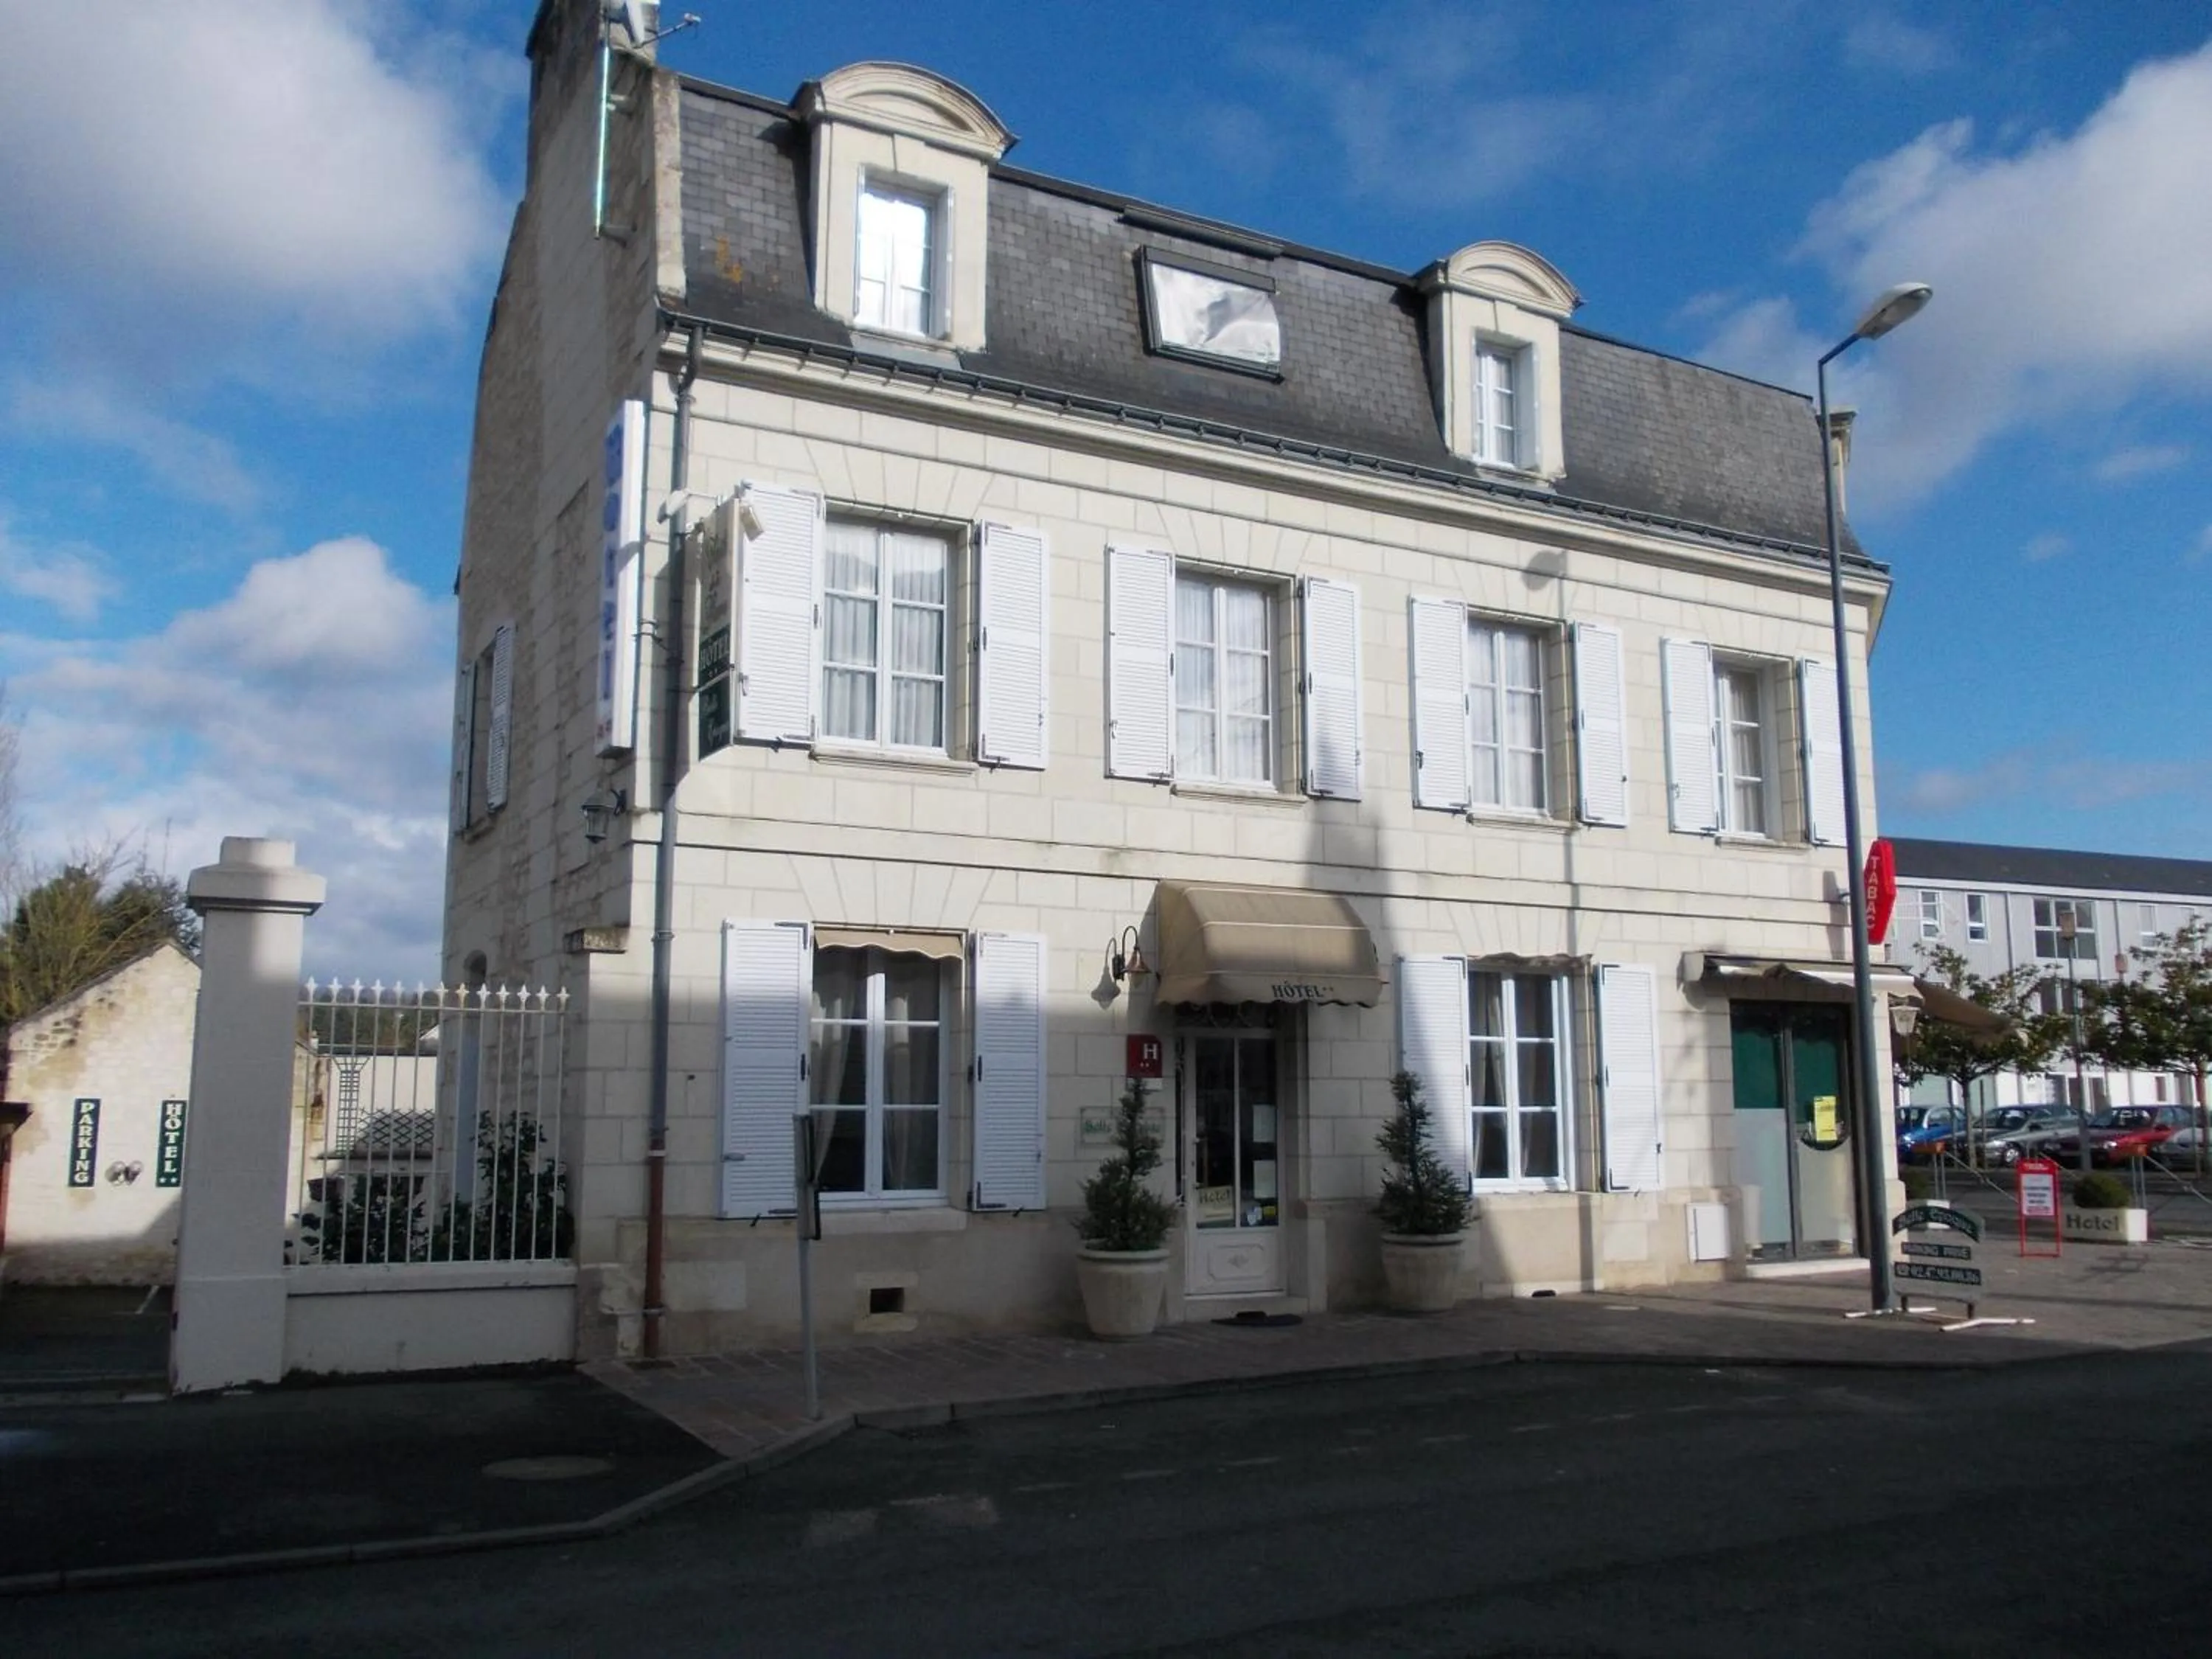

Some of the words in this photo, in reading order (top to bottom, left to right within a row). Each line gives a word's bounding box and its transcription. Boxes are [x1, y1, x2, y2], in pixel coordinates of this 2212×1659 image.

[1866, 855, 1880, 929] TABAC
[1144, 1043, 1158, 1060] H
[74, 1102, 95, 1183] PARKING
[2066, 1214, 2119, 1230] Hotel
